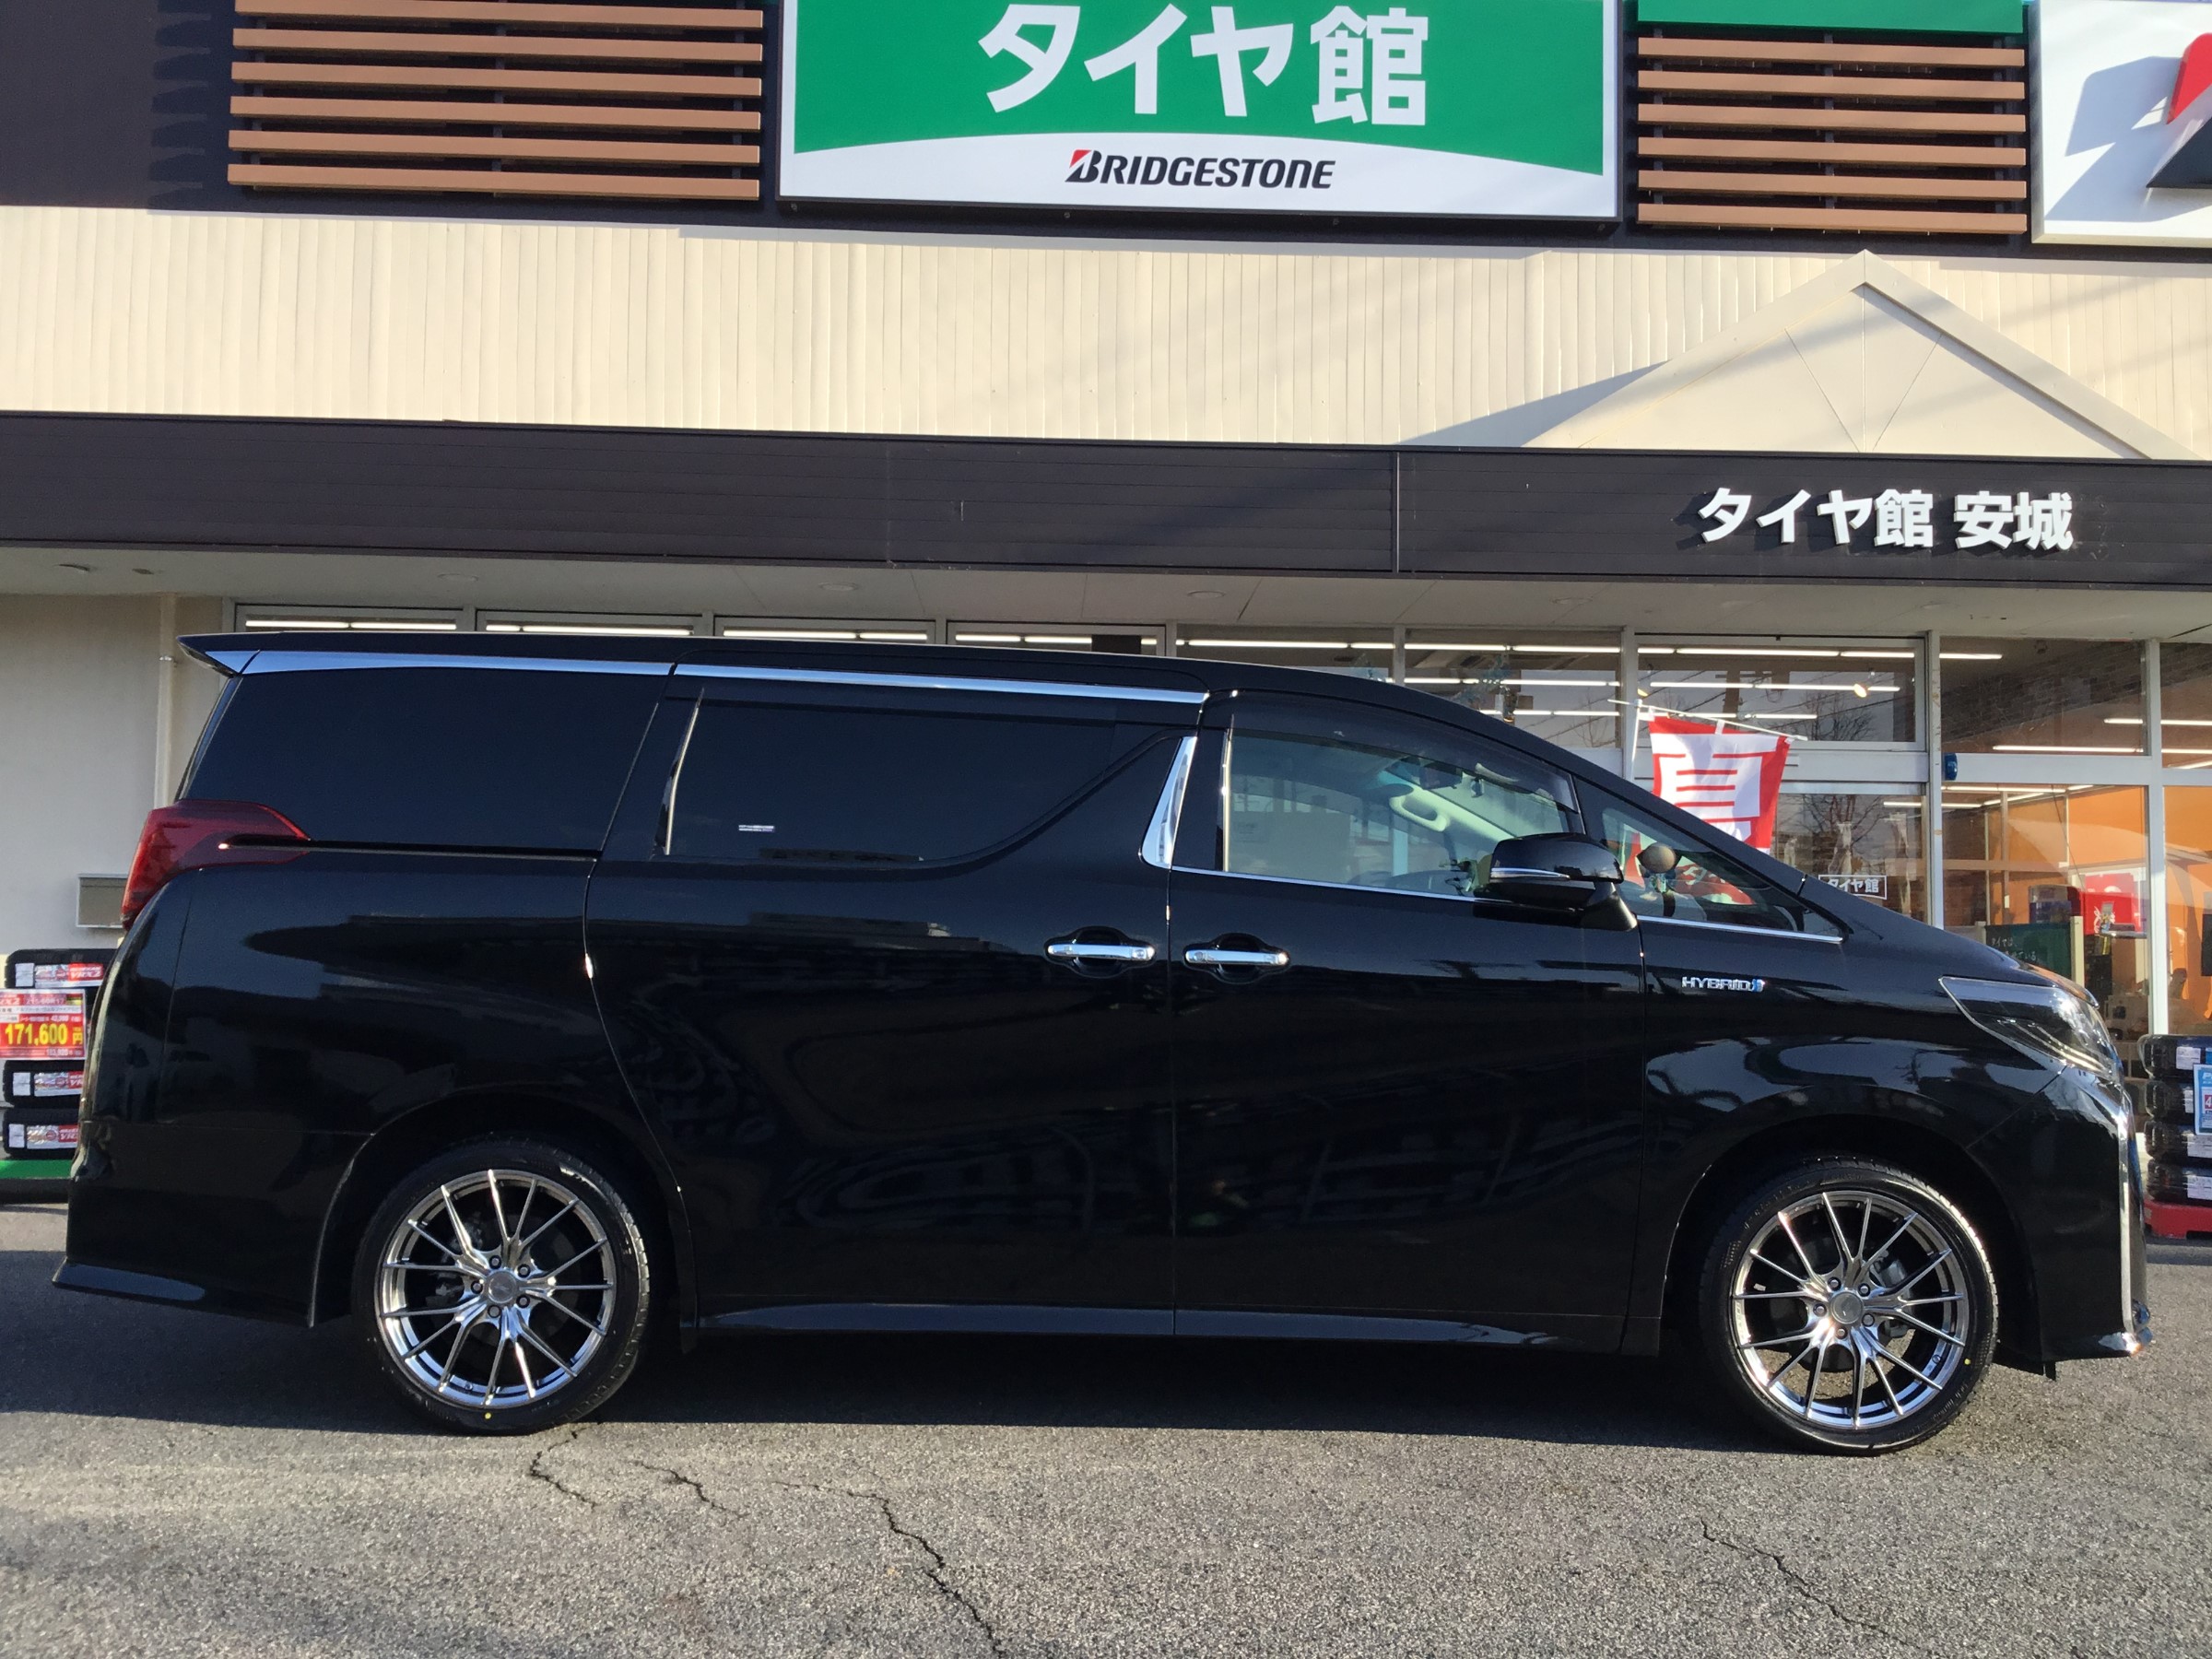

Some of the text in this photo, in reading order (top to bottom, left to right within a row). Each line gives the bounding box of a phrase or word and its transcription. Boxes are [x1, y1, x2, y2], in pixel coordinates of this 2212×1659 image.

[978, 3, 1428, 125] タイヤ館
[1065, 149, 1335, 189] BRIDGESTONE
[1698, 487, 2074, 551] タイヤ館 安城
[1681, 976, 1751, 992] HYBRID
[6, 1023, 67, 1045] 171,600
